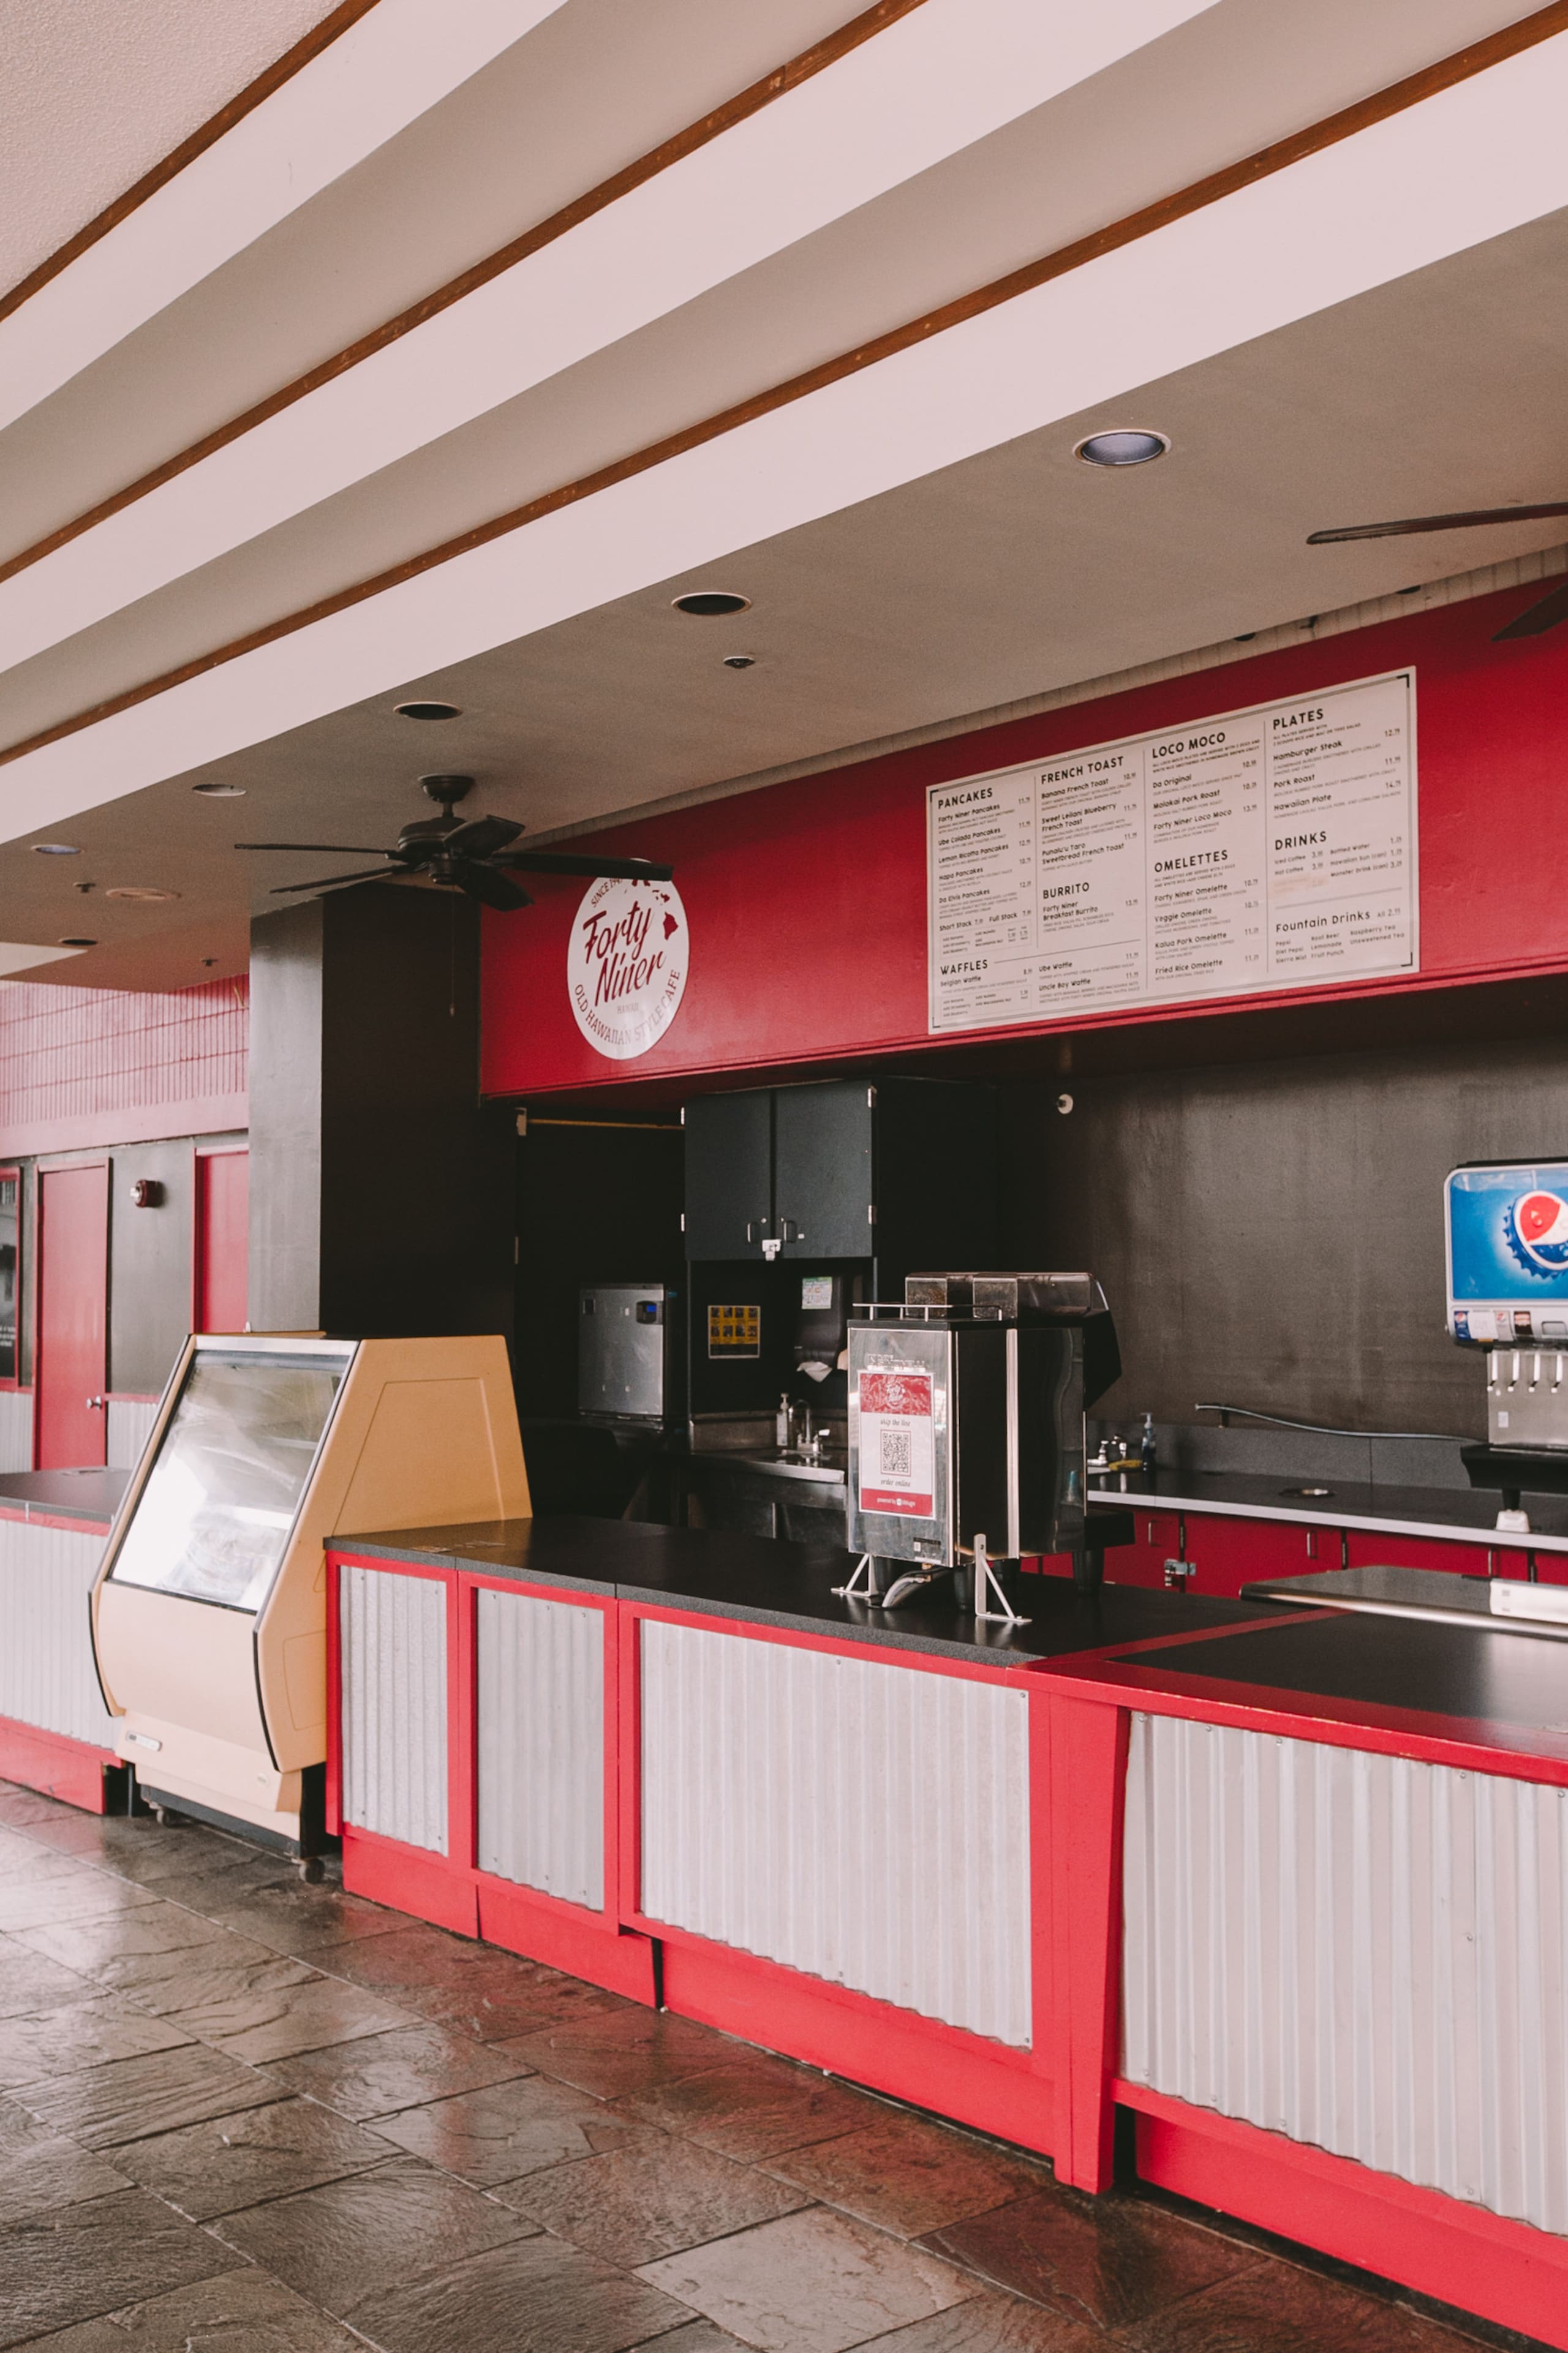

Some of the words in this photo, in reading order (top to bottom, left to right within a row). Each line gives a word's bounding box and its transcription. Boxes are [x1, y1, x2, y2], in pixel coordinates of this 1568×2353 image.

[1272, 707, 1324, 730] PLATES
[1152, 741, 1184, 759] LOCO
[1188, 731, 1226, 750] MOCO
[1273, 746, 1318, 761] Hamburger
[1319, 740, 1343, 751] Steak
[1041, 765, 1083, 785] FRENCH
[1087, 755, 1124, 773] TOAST
[1041, 788, 1066, 799] Banana
[1066, 782, 1089, 792] French
[1090, 777, 1109, 788] Toast
[1163, 774, 1192, 786] Original
[1273, 779, 1291, 788] Pork
[1293, 774, 1315, 784] Roast
[937, 787, 993, 809] PANCAKES
[1153, 798, 1180, 809] Molokai
[1181, 794, 1198, 803] Pork
[1199, 789, 1220, 799] Roast
[1311, 794, 1332, 804] Plate
[938, 814, 953, 823] Forty
[971, 804, 1000, 815] Pancakes
[1041, 814, 1060, 824] Sweet
[1084, 803, 1116, 815] Blueberry
[1153, 821, 1172, 830] Forty
[1173, 817, 1193, 826] Niner
[1194, 813, 1212, 822] Loco
[1212, 809, 1232, 818] Moco
[971, 827, 1001, 838] Pancakes
[1041, 822, 1063, 832] French
[1064, 818, 1082, 827] Toast
[1069, 842, 1085, 851] Taro
[1274, 830, 1327, 851] DRINKS
[938, 854, 957, 864] Lemon
[958, 849, 979, 859] Ricotta
[979, 843, 1009, 854] Pancakes
[1041, 851, 1080, 865] Sweetbread
[1081, 846, 1104, 856] French
[1105, 842, 1124, 851] Toast
[1153, 849, 1227, 873] OMELETTES
[955, 867, 983, 877] Pancakes
[591, 881, 609, 908] SINCE
[961, 889, 990, 898] Pancakes
[1042, 881, 1090, 899] BURRITO
[1154, 893, 1173, 902] Forty
[1174, 889, 1194, 898] Niner
[1194, 884, 1227, 895] Omelette
[1000, 911, 1017, 920] Stack
[1042, 904, 1060, 913] Forty
[1042, 909, 1074, 921] Breakfast
[1075, 906, 1098, 916] Burrito
[1154, 913, 1178, 923] Veggie
[1179, 907, 1212, 919] Omelette
[939, 923, 955, 932] Short
[956, 920, 972, 928] Stack
[1275, 916, 1327, 933] Fountain
[1332, 910, 1370, 924] Drinks
[582, 900, 654, 964] Forty
[1176, 936, 1193, 945] Pork
[1194, 932, 1227, 943] Omelette
[1349, 927, 1382, 936] Raspberry
[1349, 933, 1391, 945] Unsweetened
[1310, 941, 1342, 951] Lemonade
[940, 958, 988, 975] WAFFLES
[1052, 961, 1072, 969] Waffle
[1155, 965, 1173, 974] Fried
[1190, 959, 1223, 969] Omelette
[595, 951, 666, 1006] Niner
[1070, 977, 1091, 987] Waffle
[575, 984, 589, 1012] OLD
[586, 1009, 631, 1045] HAWAIIAN
[634, 1006, 665, 1041] STYLE
[661, 969, 680, 1009] CAFE
